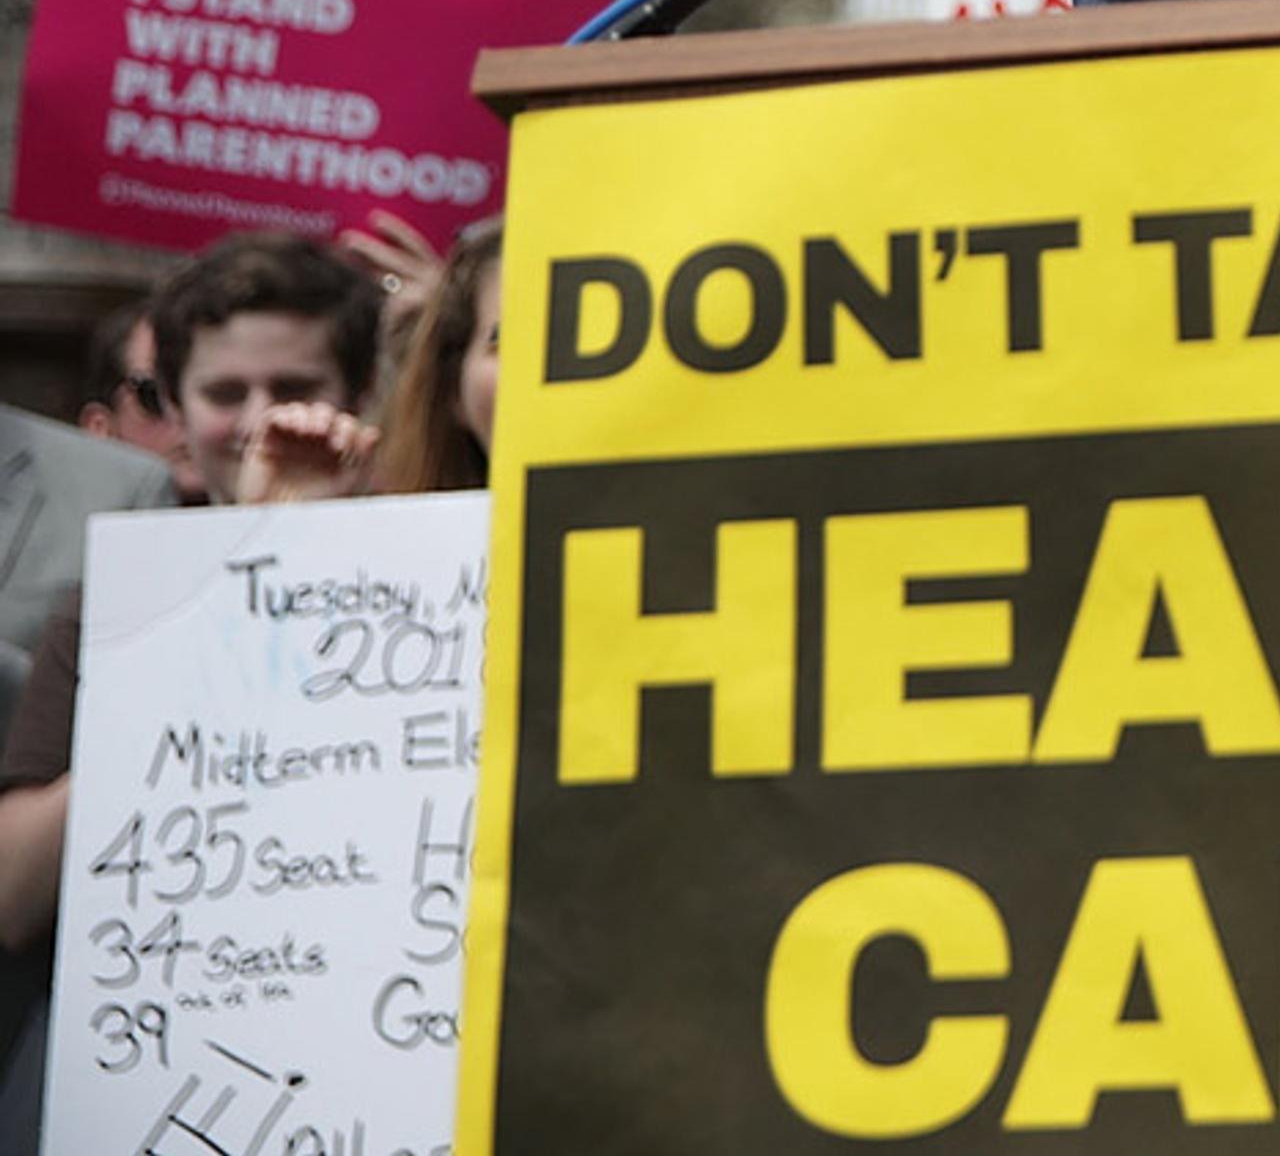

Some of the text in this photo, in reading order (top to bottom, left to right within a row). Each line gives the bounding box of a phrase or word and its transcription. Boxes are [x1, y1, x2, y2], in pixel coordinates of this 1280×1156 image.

[125, 8, 280, 76] WITH
[112, 57, 380, 141] PLANNED
[105, 108, 491, 206] PARENTHOOD
[542, 218, 1080, 385] DON'T
[225, 553, 433, 623] Tuesday,
[301, 613, 487, 701] 201
[145, 720, 380, 788] Midterm
[88, 801, 250, 908] 435
[249, 837, 380, 895] Seat
[88, 911, 202, 988] 34
[204, 931, 328, 982] Seats
[88, 1003, 170, 1074] 39
